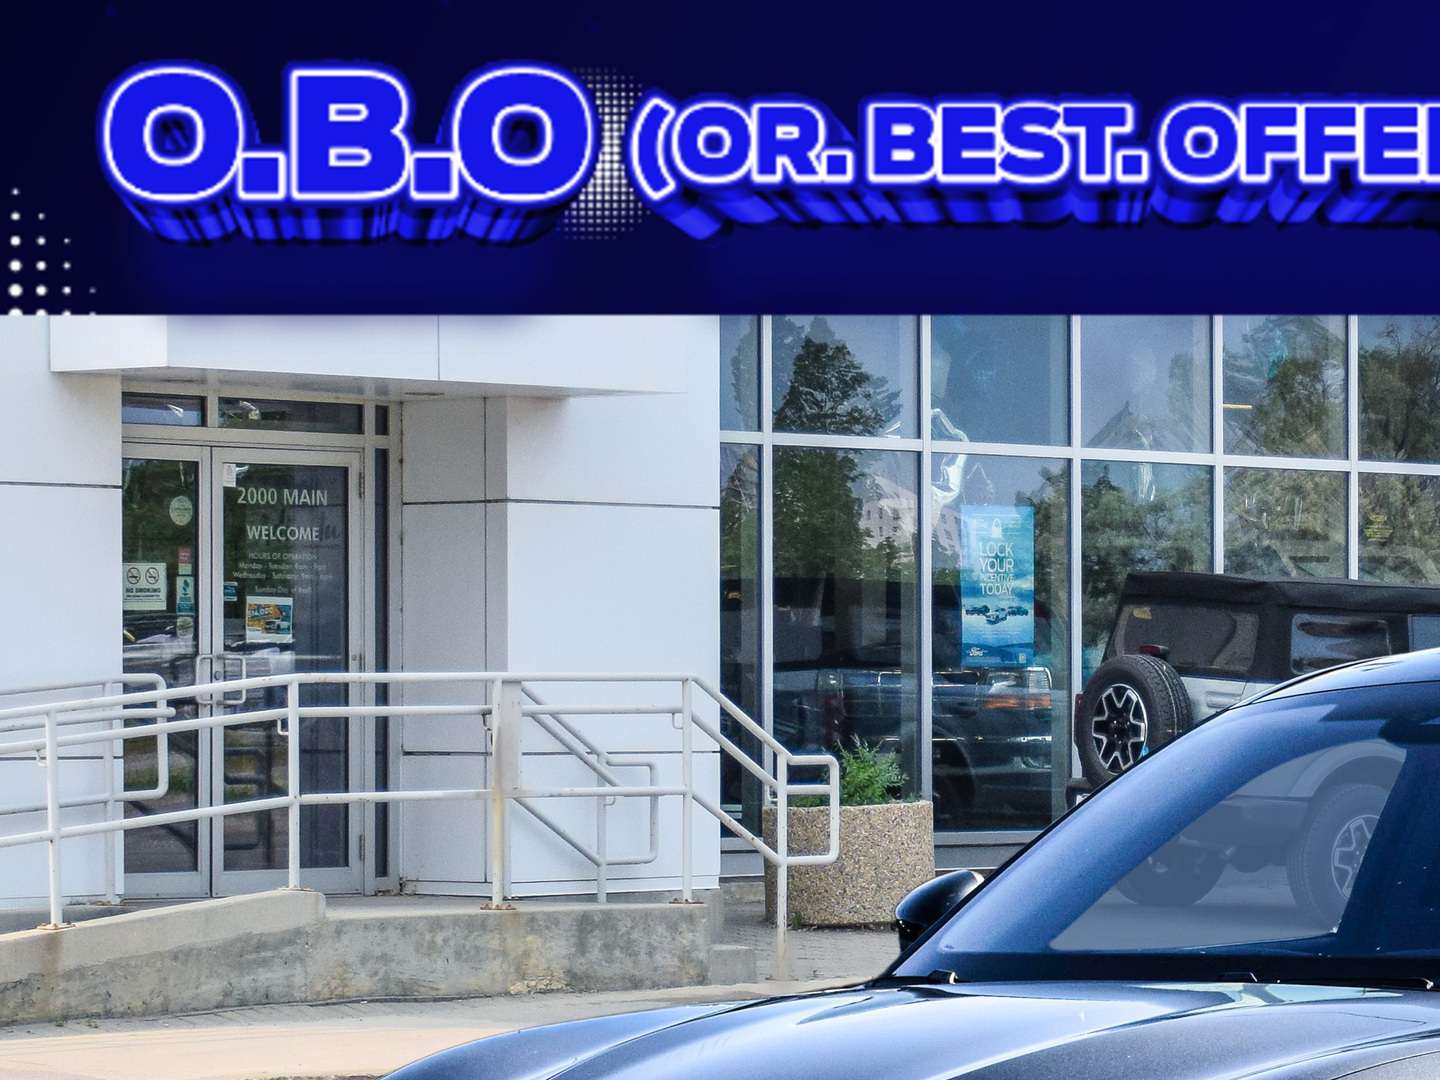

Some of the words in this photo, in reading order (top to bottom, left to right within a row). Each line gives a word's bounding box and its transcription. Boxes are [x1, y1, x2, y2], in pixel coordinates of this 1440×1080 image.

[237, 487, 277, 504] 2000
[283, 489, 328, 506] MAIN
[246, 525, 320, 541] WELCOME
[979, 541, 1014, 557] LOCK
[979, 558, 1015, 573] YOUR
[980, 583, 1013, 595] TODAY
